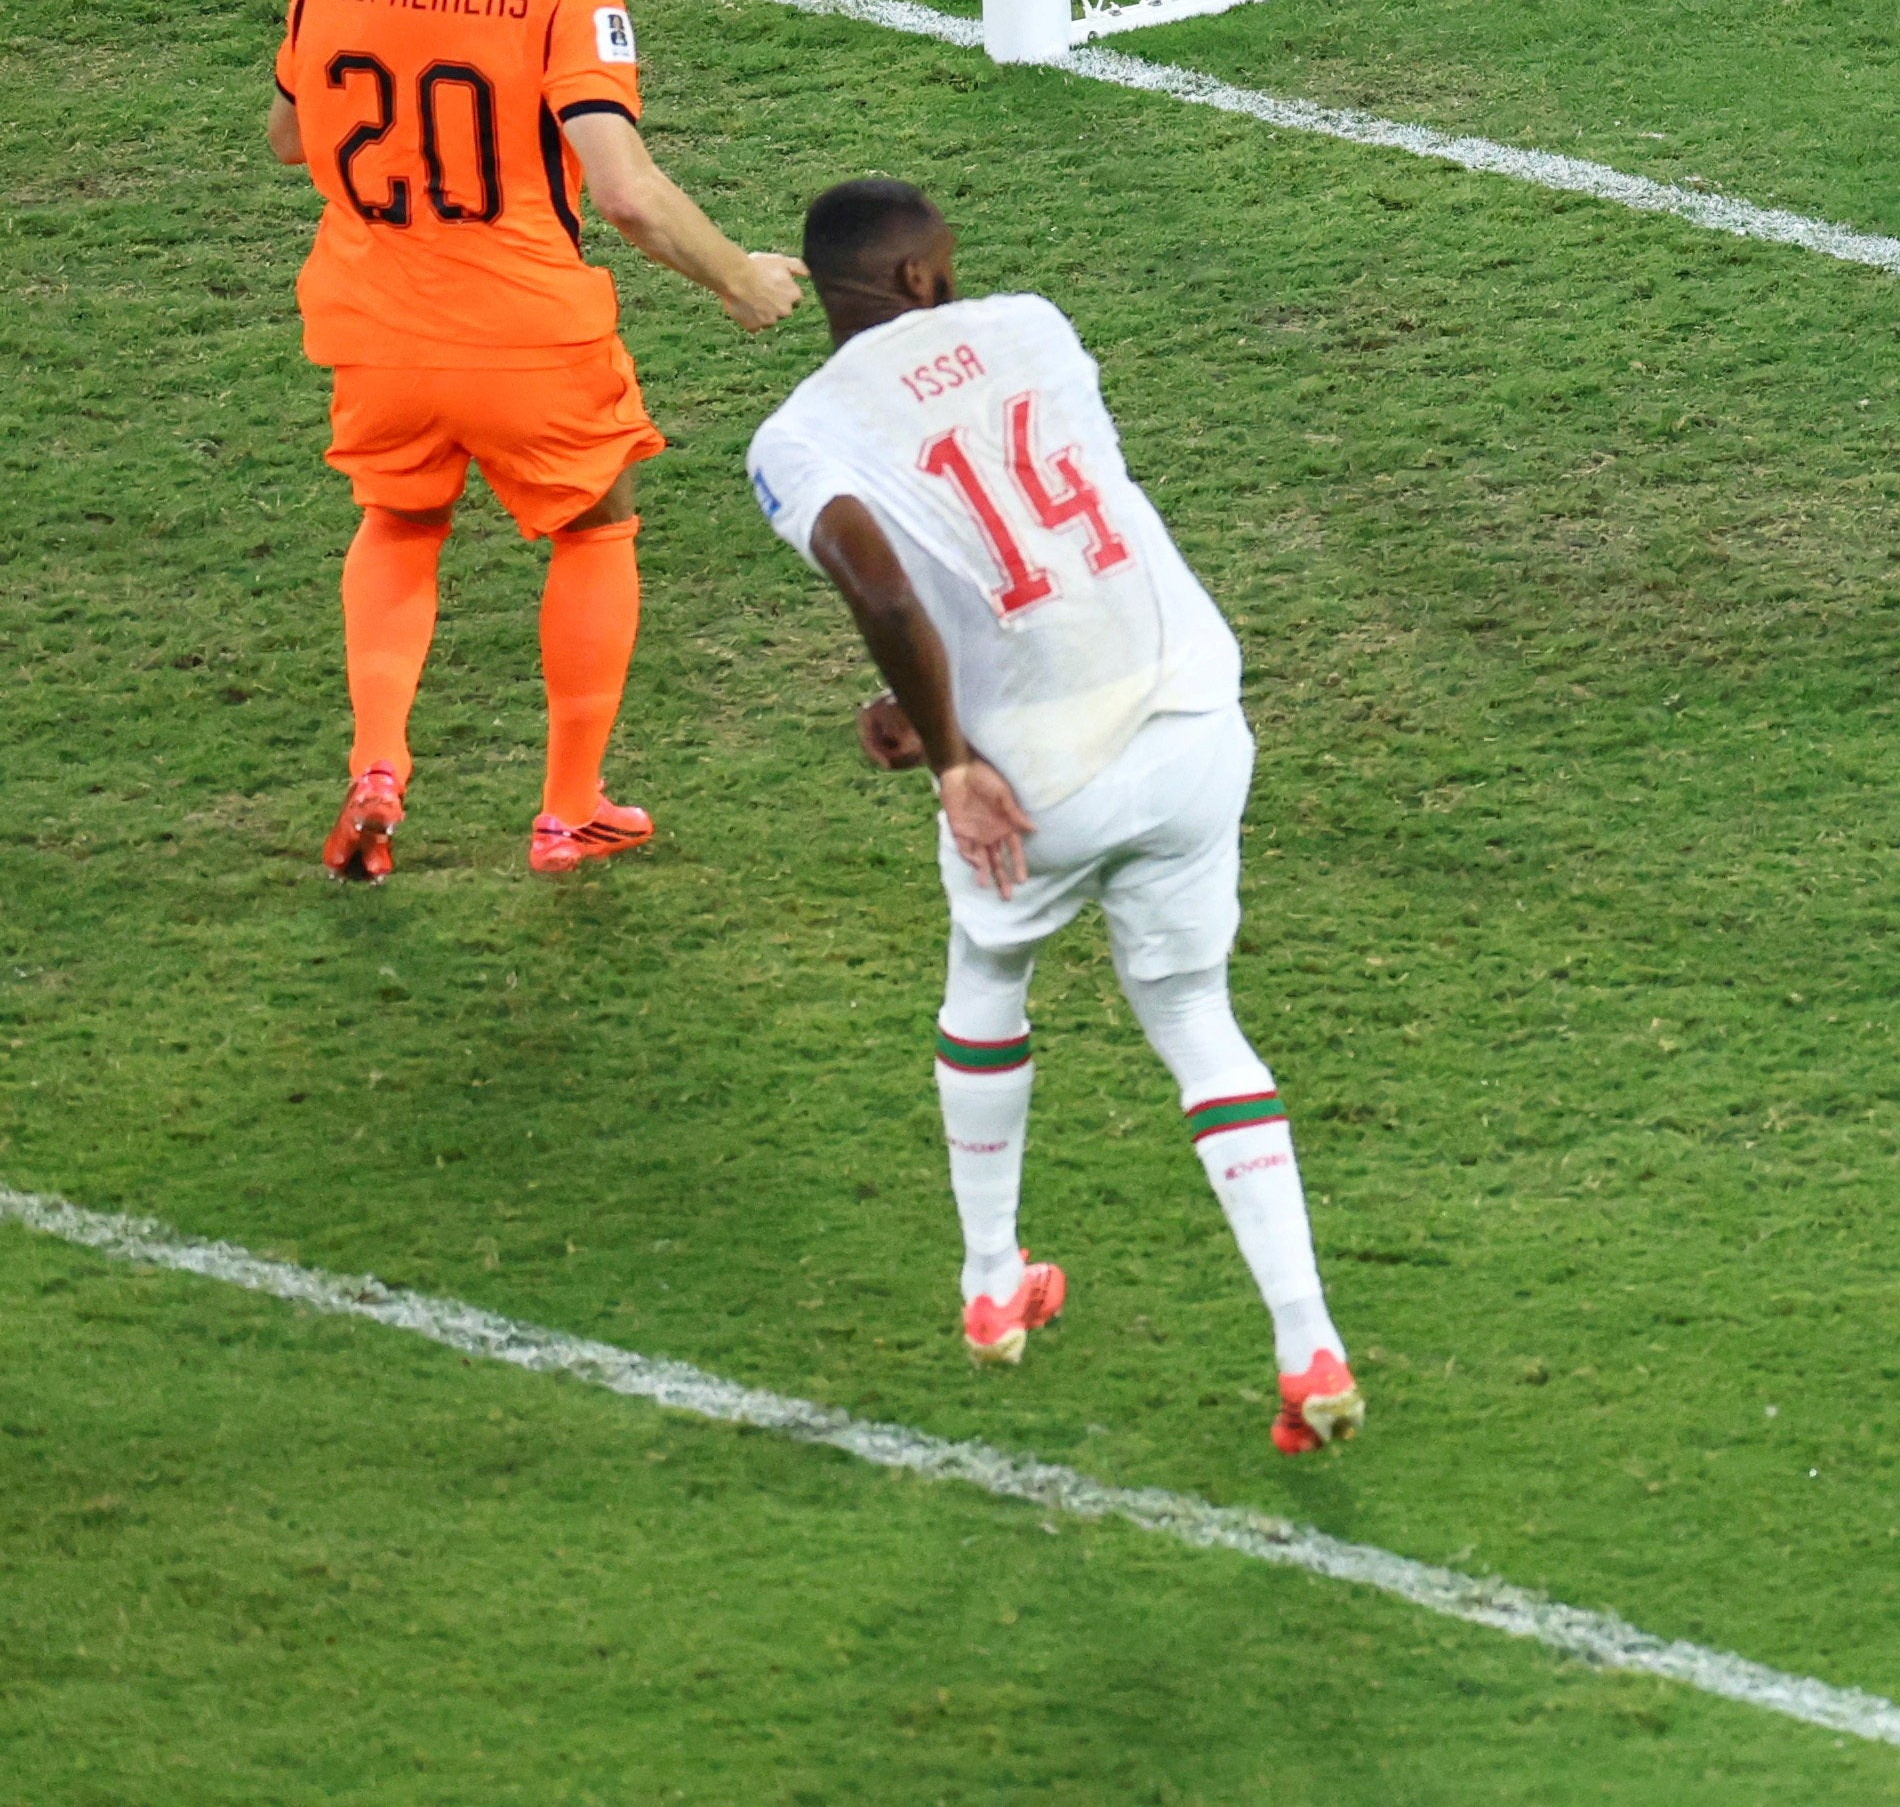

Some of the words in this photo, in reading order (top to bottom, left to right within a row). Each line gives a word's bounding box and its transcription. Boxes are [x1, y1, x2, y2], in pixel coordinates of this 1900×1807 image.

[325, 49, 502, 230] 20
[900, 343, 987, 403] ISSA
[916, 390, 1139, 623] 14
